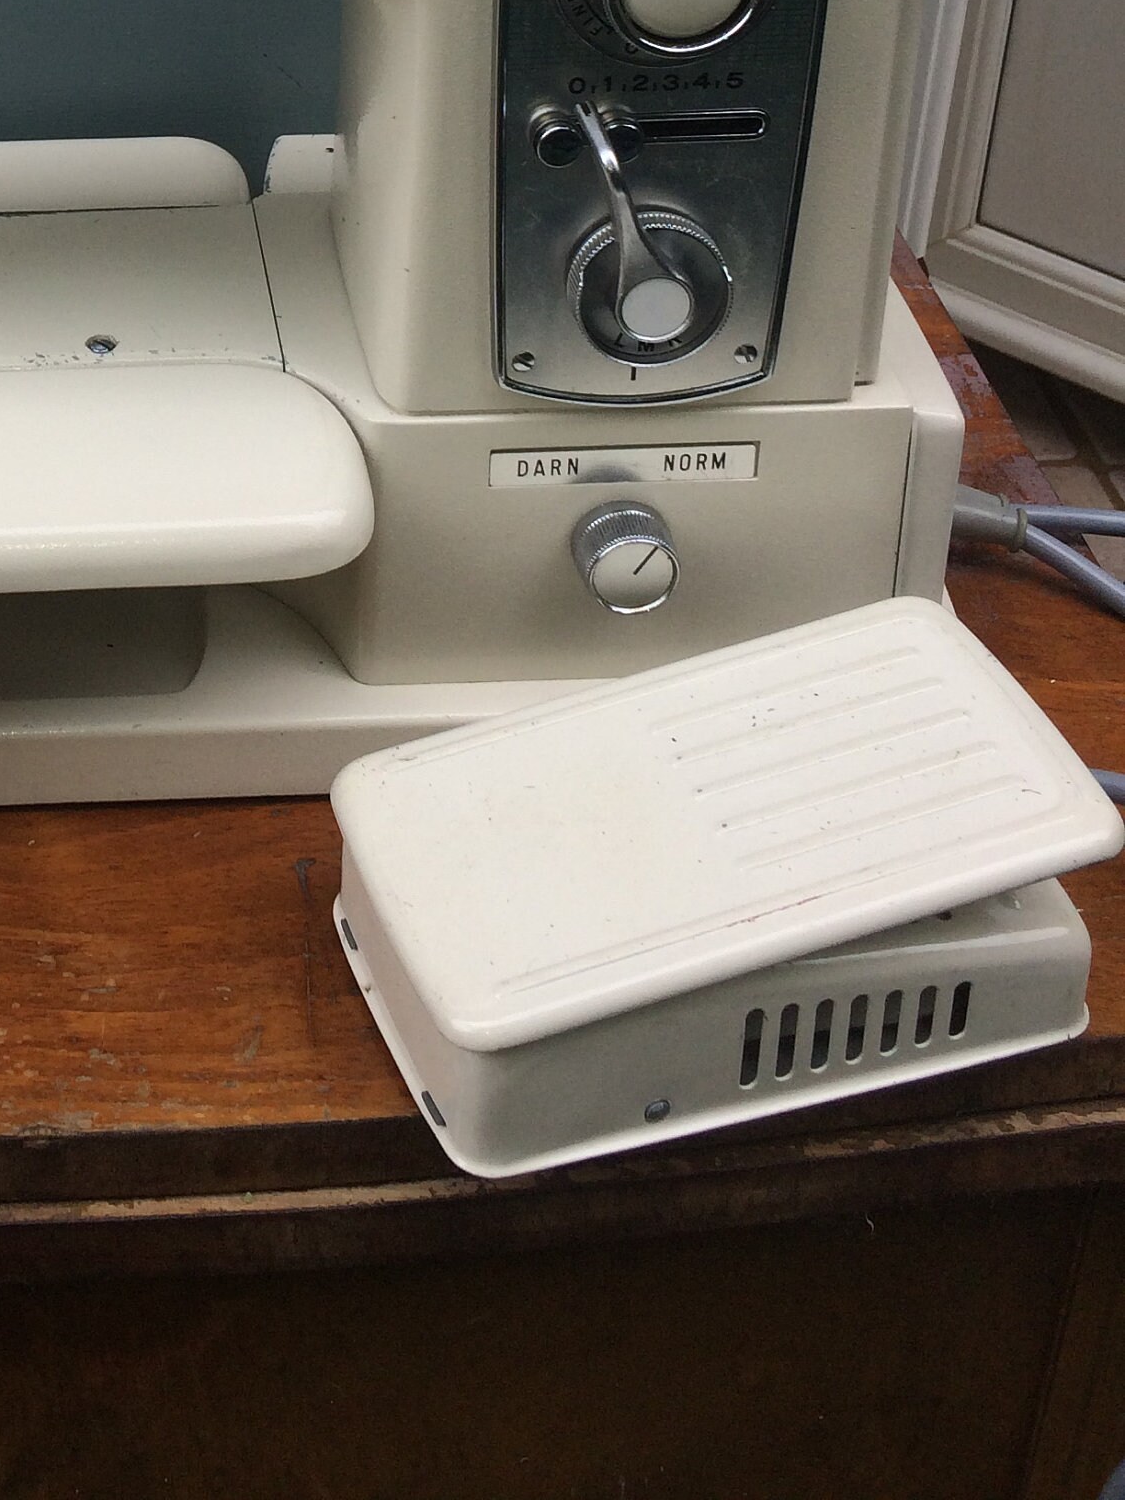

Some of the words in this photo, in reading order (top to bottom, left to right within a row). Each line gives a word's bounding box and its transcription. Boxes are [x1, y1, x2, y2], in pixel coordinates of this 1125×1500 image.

[568, 77, 586, 94] 0
[604, 76, 613, 92] 1
[632, 74, 650, 91] 2
[662, 74, 680, 91] 3
[693, 72, 711, 88] 4
[726, 71, 744, 89] 5
[517, 458, 579, 477] DARN
[663, 451, 726, 472] NORM
